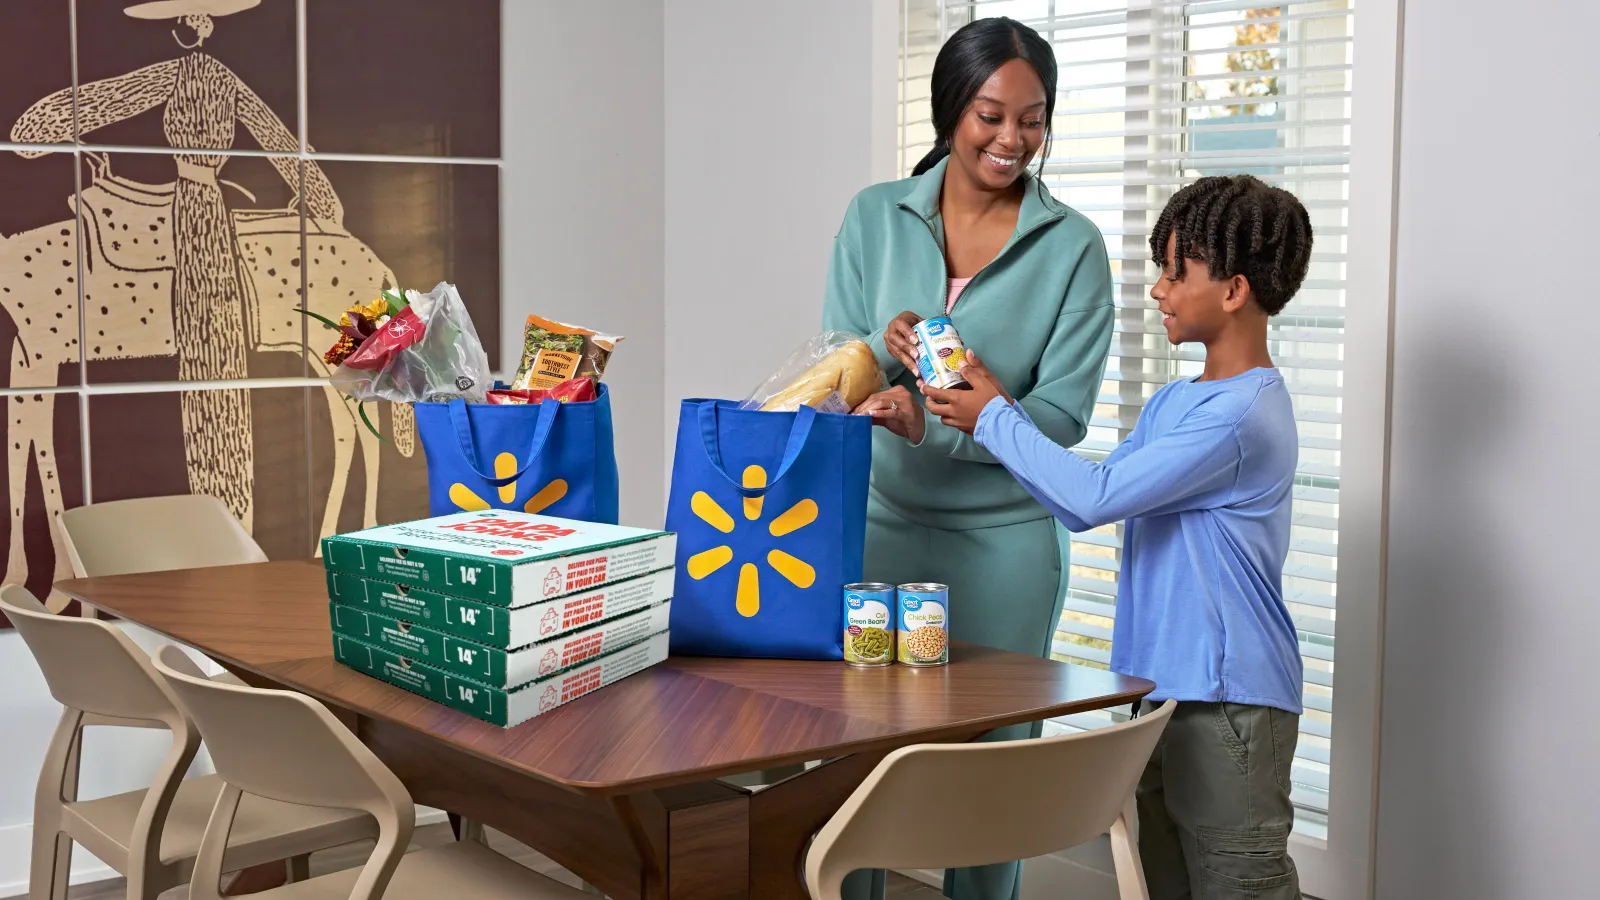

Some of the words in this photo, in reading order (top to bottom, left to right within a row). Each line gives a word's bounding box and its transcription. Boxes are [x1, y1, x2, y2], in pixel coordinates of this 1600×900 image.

[542, 358, 570, 370] SOUTHWEST
[436, 523, 558, 541] JOHNS
[469, 518, 577, 536] PAPA
[567, 571, 576, 579] GET
[577, 569, 588, 577] PAID
[595, 565, 606, 573] SING
[568, 561, 585, 570] DELIVER
[460, 566, 481, 585] 14"
[566, 581, 573, 591] IN
[575, 576, 592, 588] YOUR
[593, 573, 606, 584] CAR
[565, 600, 582, 609] DELIVER
[573, 607, 585, 615] PAID
[592, 602, 603, 610] SING
[460, 607, 480, 626] 14"
[562, 619, 570, 629] IN
[571, 614, 589, 626] YOUR
[590, 609, 603, 620] CAR
[563, 649, 572, 657] GET
[573, 645, 584, 654] PAID
[591, 639, 602, 647] SING
[564, 639, 582, 649] DELIVER
[457, 647, 477, 665] 14"
[561, 658, 569, 667] IN
[570, 651, 587, 663] YOUR
[588, 646, 601, 656] CAR
[562, 685, 571, 693] GET
[571, 680, 582, 689] PAID
[589, 673, 601, 681] SING
[563, 674, 580, 685] DELIVER
[459, 686, 479, 704] 14"
[561, 693, 568, 702] IN
[570, 685, 587, 697] YOUR
[588, 680, 600, 690] CAR
